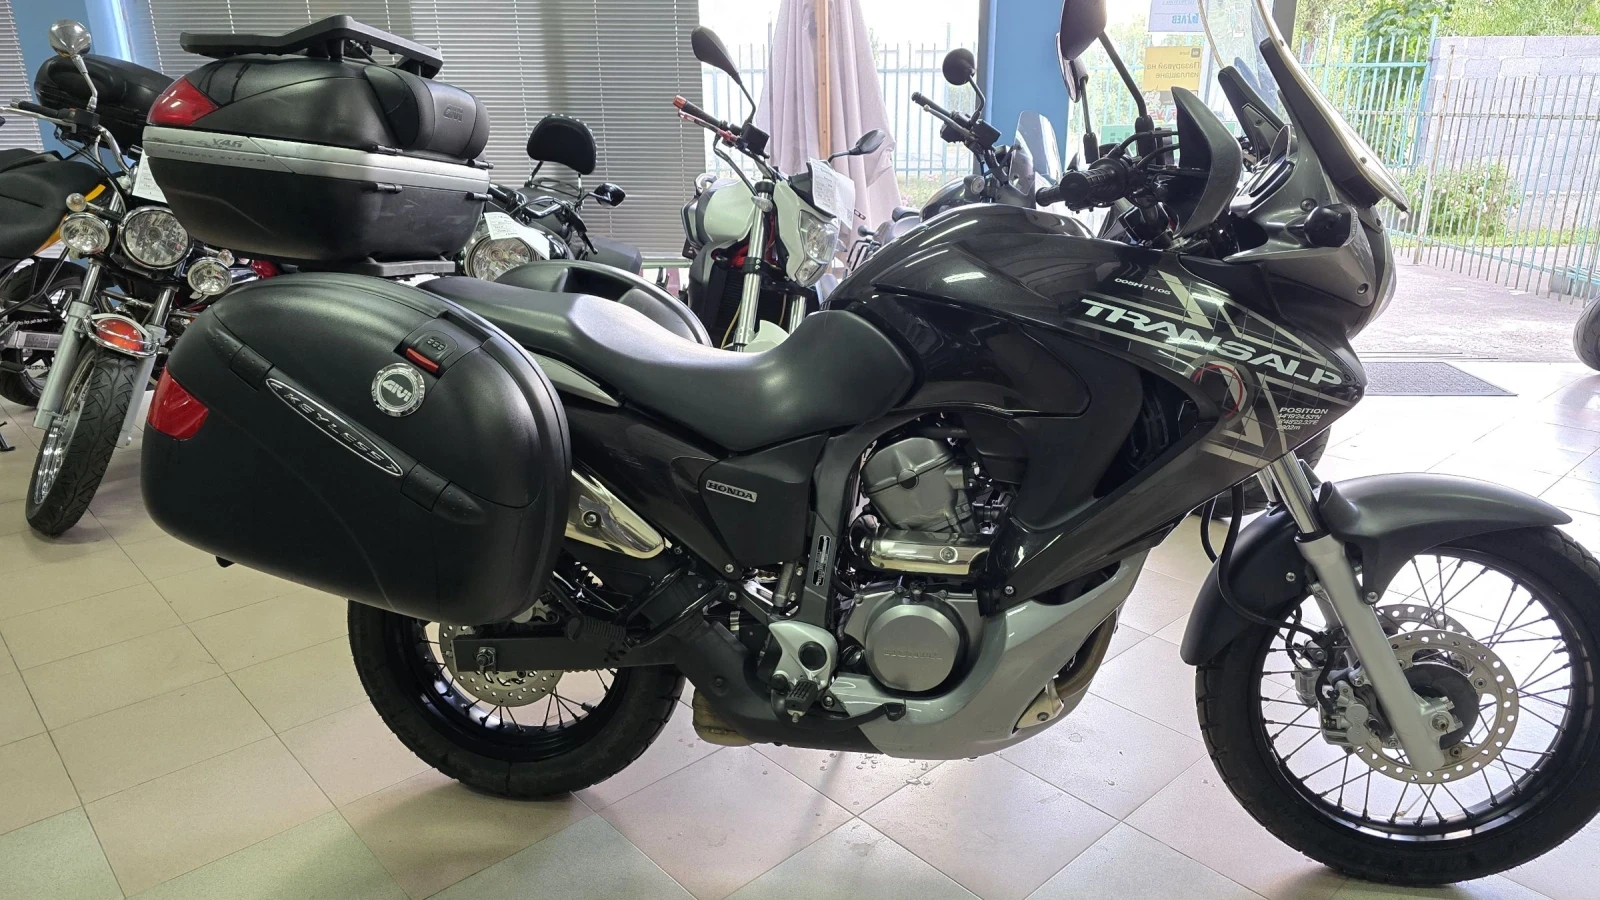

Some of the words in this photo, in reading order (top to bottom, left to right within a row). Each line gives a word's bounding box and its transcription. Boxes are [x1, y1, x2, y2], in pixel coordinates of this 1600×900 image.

[1081, 298, 1343, 386] TRANSALP
[382, 379, 413, 402] GIVI
[1279, 407, 1328, 415] POSITION
[283, 393, 385, 461] KEYLESS
[707, 481, 755, 501] HONDA
